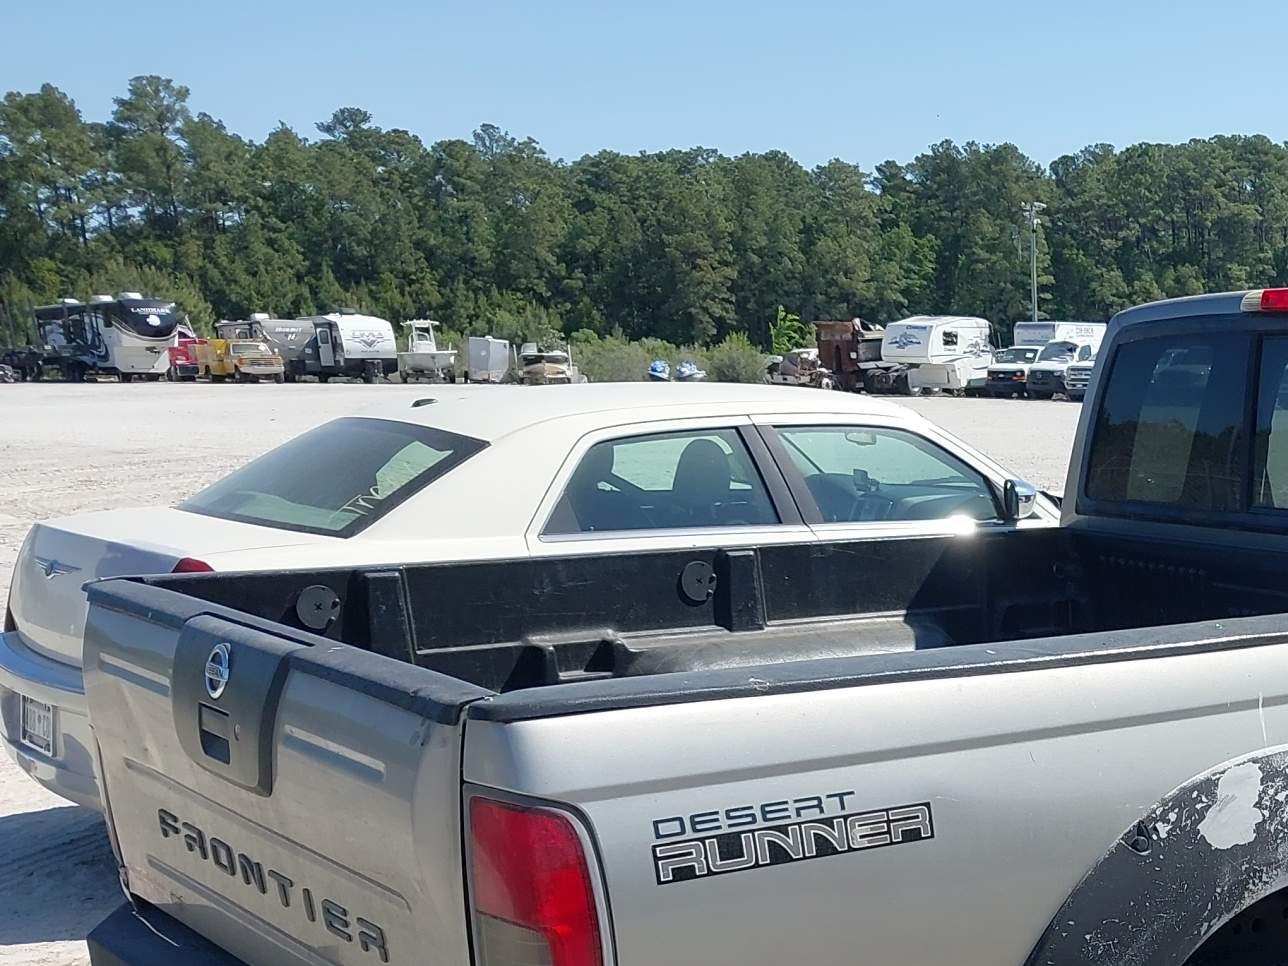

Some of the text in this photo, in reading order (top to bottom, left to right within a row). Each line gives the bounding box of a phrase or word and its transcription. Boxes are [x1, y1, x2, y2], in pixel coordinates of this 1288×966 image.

[652, 790, 856, 840] DESERT
[655, 804, 932, 883] RUNNER
[157, 808, 391, 964] FRONTIER
